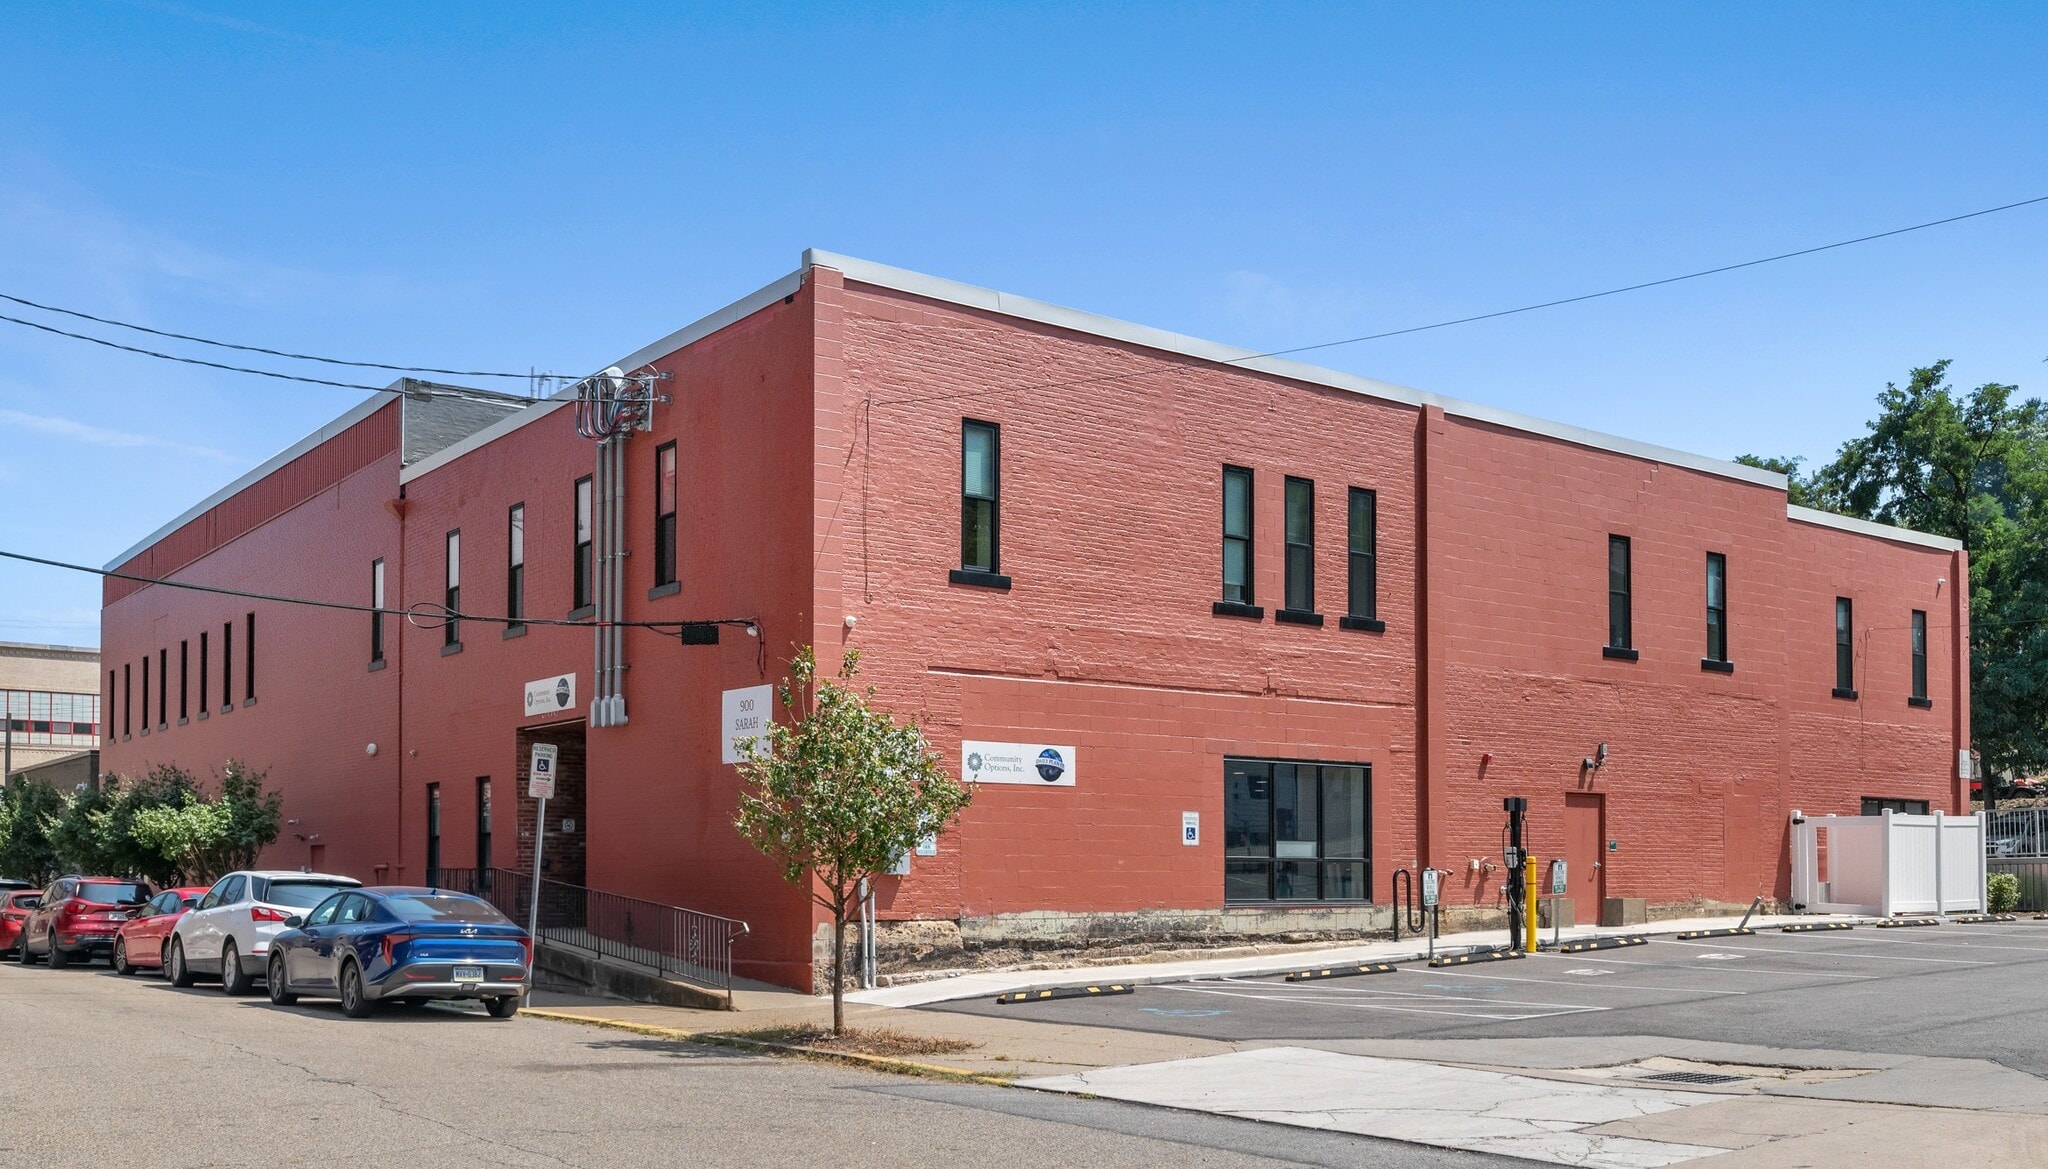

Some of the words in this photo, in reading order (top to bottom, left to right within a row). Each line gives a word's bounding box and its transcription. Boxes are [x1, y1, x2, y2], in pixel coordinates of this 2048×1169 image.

[739, 699, 755, 712] 900
[735, 716, 759, 731] SARAH
[984, 753, 1023, 764] Community
[984, 763, 1012, 772] Options,
[1013, 764, 1025, 772] Inc.
